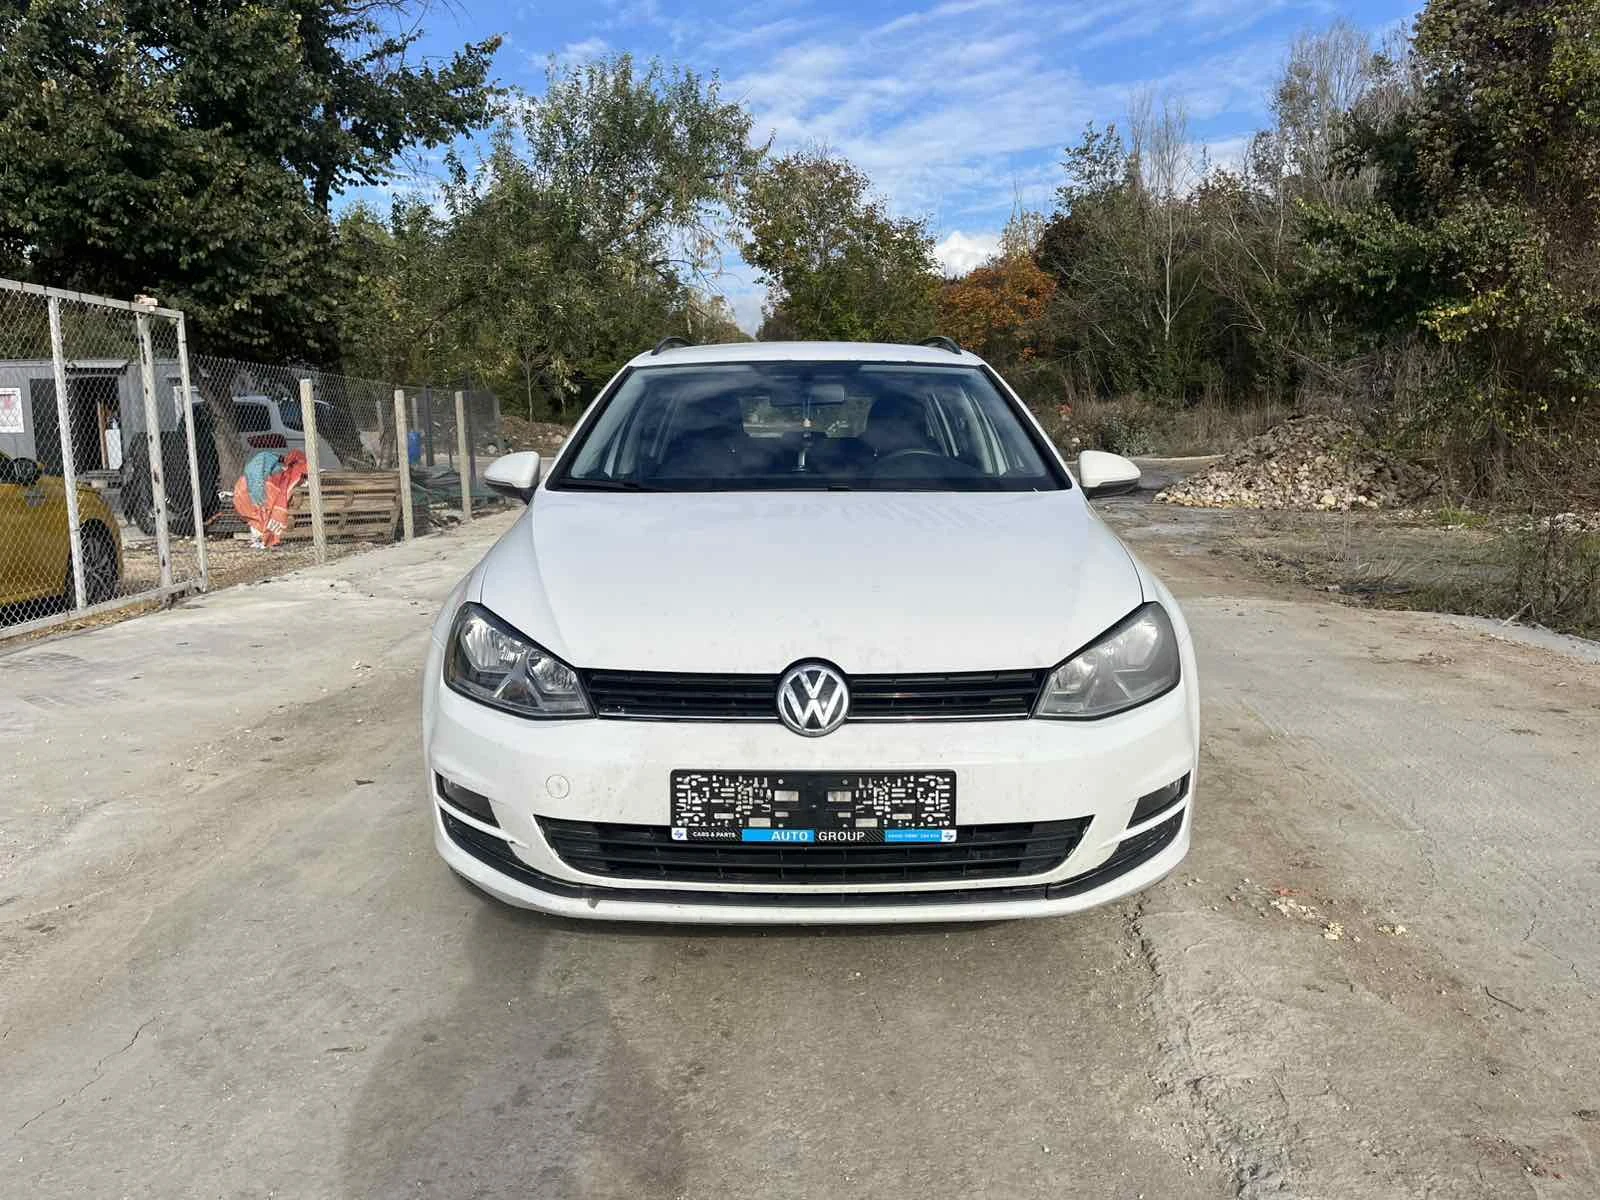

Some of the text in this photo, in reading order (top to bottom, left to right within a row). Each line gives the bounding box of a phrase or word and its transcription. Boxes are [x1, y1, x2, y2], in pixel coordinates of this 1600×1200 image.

[783, 669, 842, 730] VW
[715, 831, 736, 839] PARTS
[771, 830, 865, 841] AUTO GROUP
